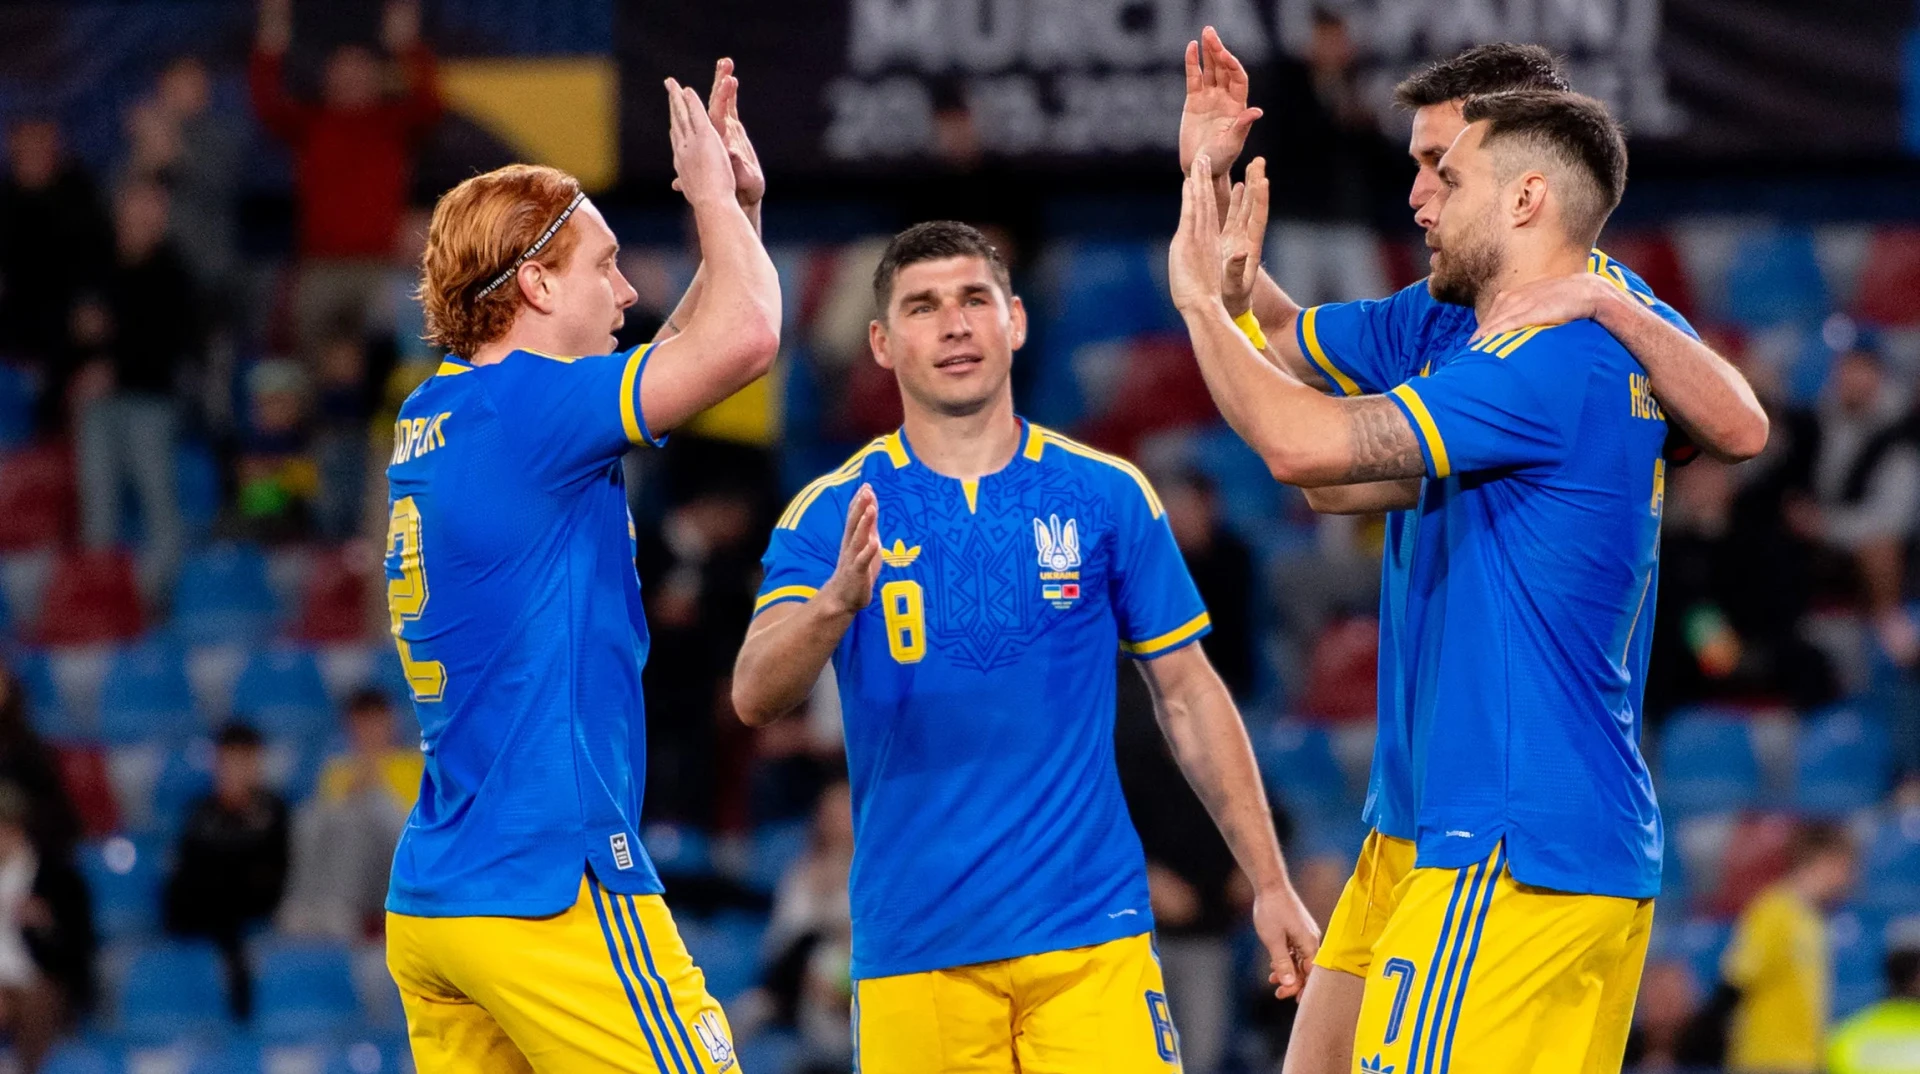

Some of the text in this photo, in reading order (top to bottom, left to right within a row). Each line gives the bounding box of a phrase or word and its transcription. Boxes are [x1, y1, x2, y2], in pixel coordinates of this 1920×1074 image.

[386, 496, 447, 702] 2
[1039, 571, 1080, 580] UKRAINE
[880, 579, 927, 665] 8
[1144, 988, 1181, 1065] 8
[1382, 957, 1417, 1047] 7
